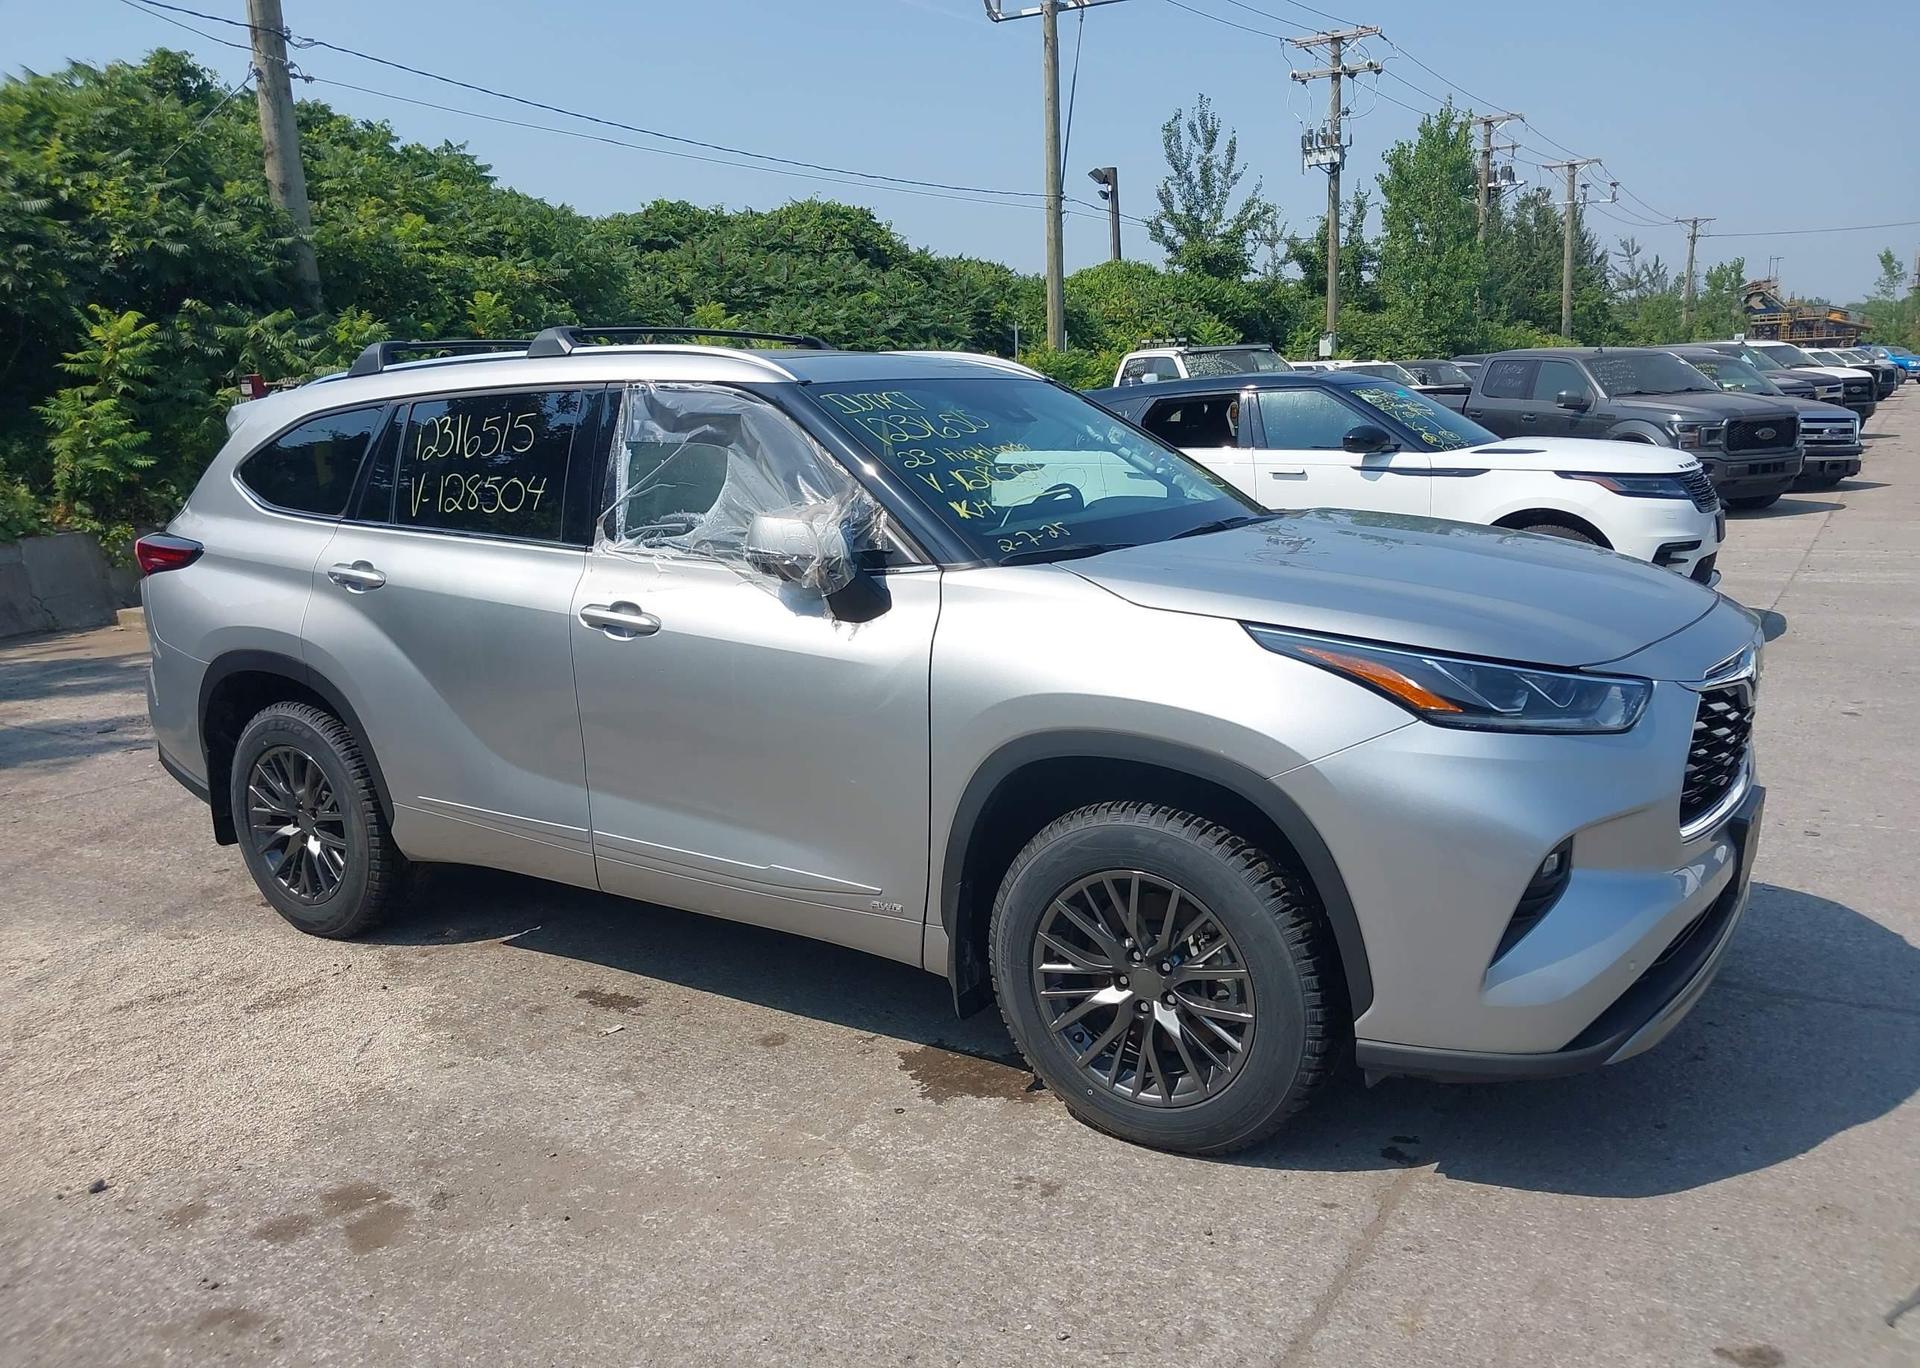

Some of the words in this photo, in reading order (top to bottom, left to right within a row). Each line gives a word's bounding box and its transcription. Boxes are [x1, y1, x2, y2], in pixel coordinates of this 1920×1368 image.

[416, 412, 537, 461] 12316515
[897, 449, 936, 469] 23
[412, 472, 547, 517] V-128504
[997, 522, 1071, 552] 2-7-25
